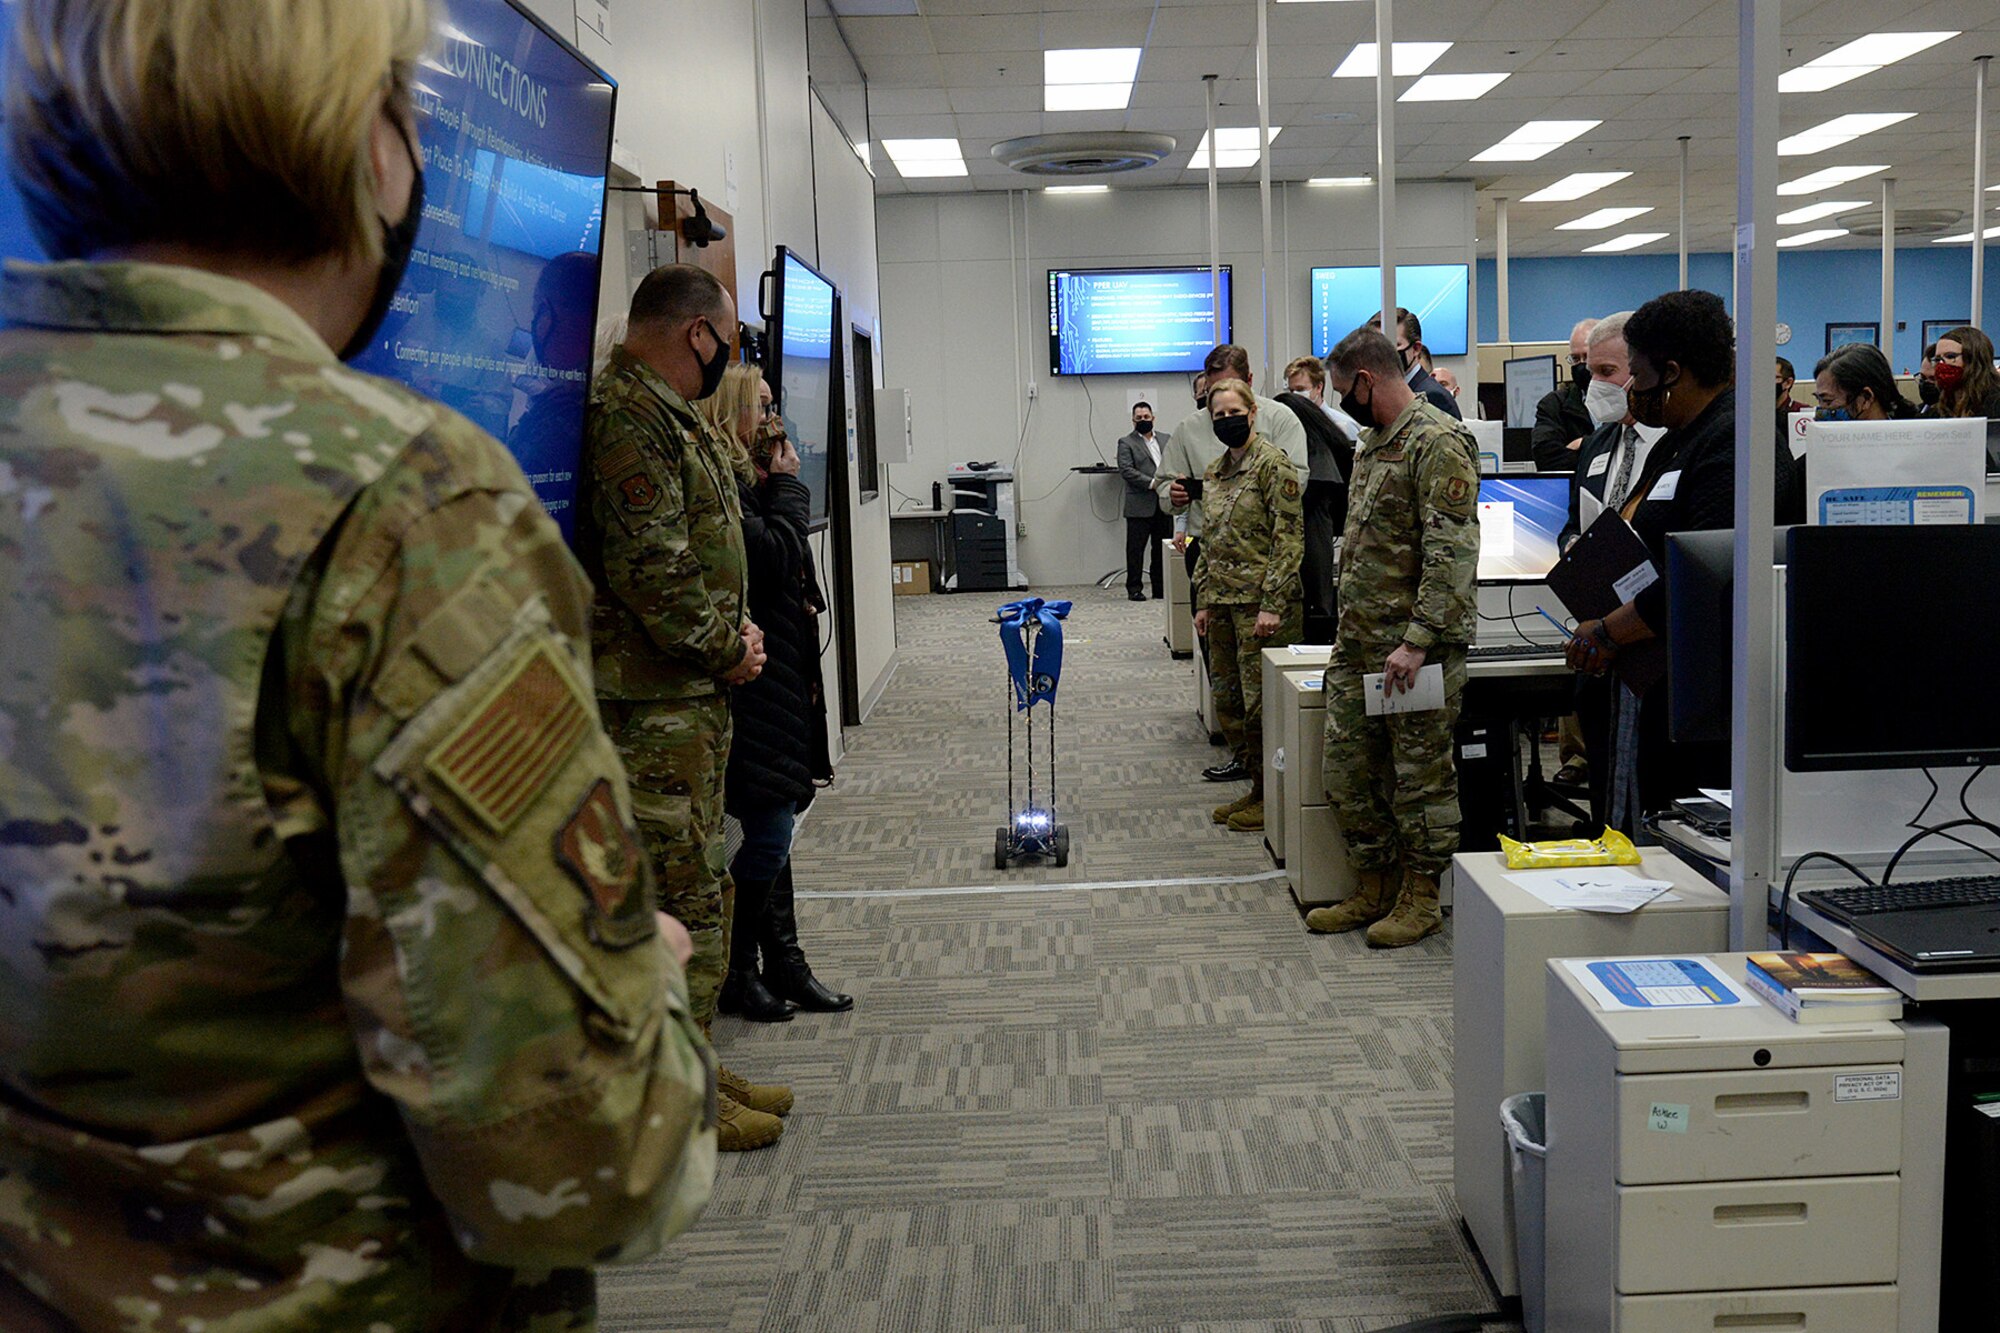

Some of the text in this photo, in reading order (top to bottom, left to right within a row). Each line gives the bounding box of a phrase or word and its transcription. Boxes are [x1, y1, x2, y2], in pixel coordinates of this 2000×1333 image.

[443, 38, 548, 129] CONNECTIONS
[435, 98, 460, 130] People
[395, 340, 429, 368] Connecting
[430, 351, 440, 364] our
[441, 350, 462, 371] people
[1820, 432, 1851, 443] YOUR
[1853, 431, 1884, 442] NAME
[1885, 430, 1913, 441] HERE
[1923, 430, 1950, 442] Open
[1951, 429, 1972, 440] Seat
